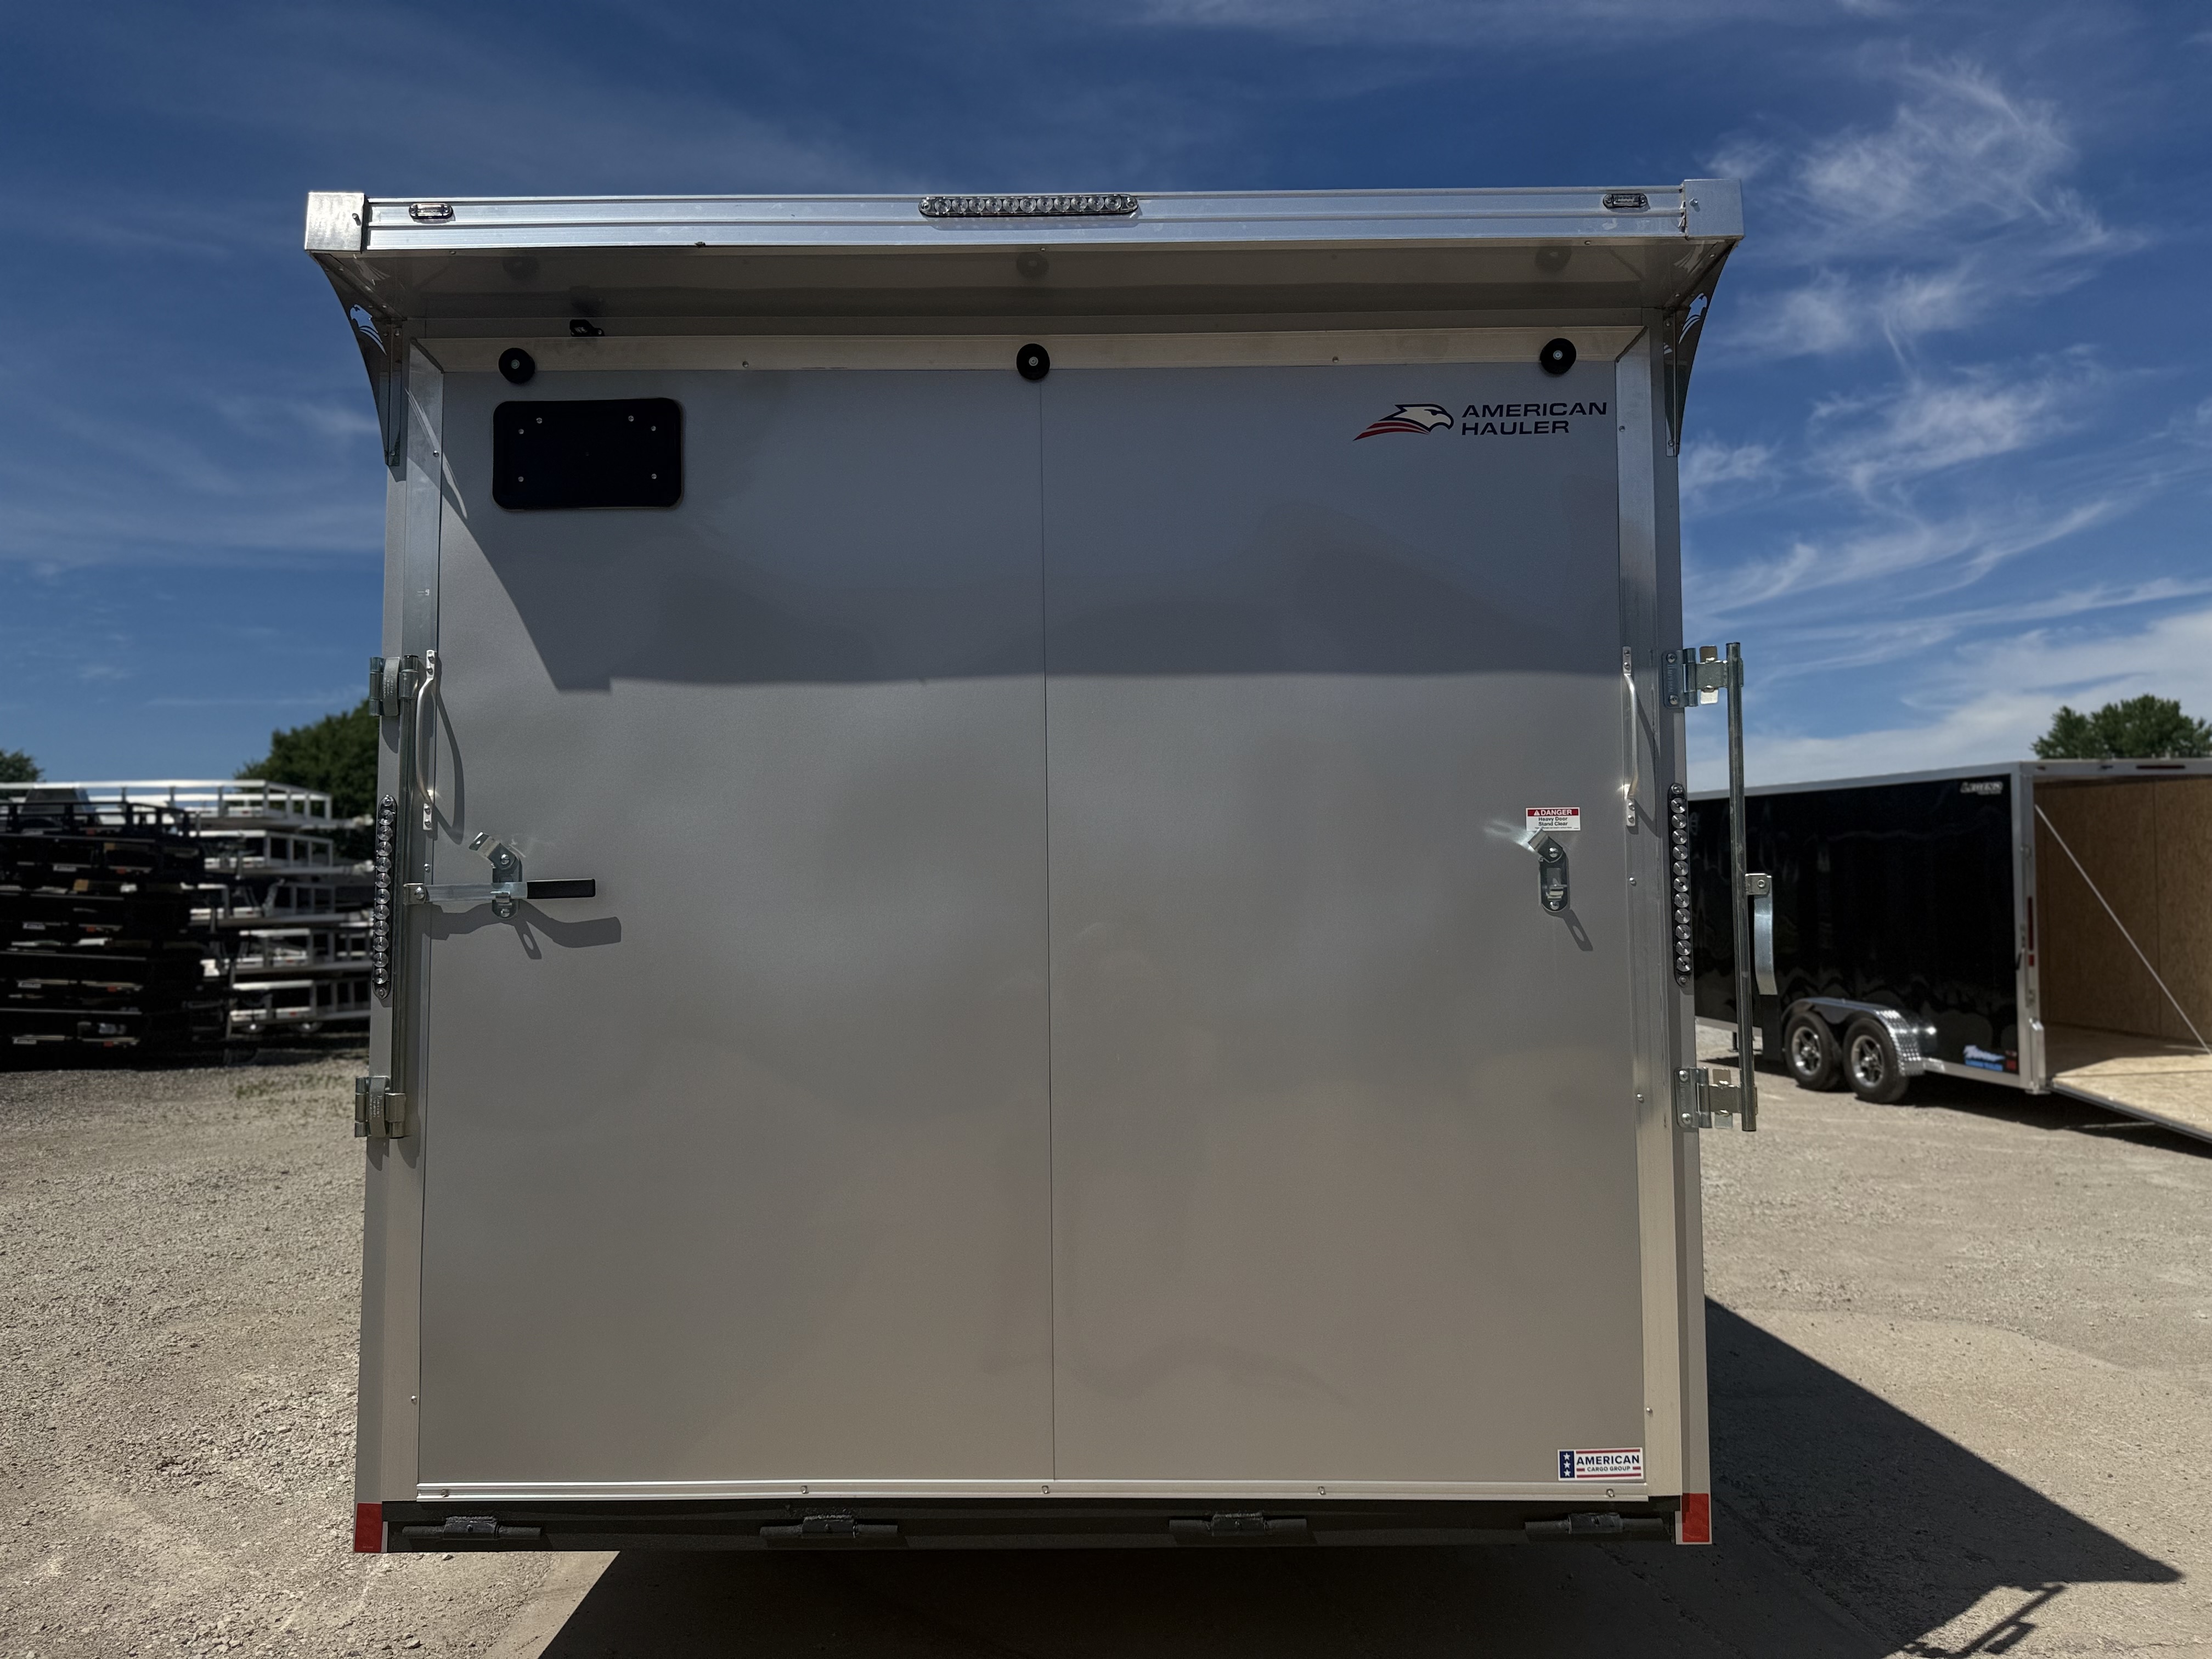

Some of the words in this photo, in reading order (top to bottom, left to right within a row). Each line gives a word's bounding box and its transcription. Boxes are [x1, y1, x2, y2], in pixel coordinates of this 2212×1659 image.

[1462, 402, 1607, 417] AMERICAN
[1462, 420, 1570, 435] HAULER
[1576, 1455, 1639, 1465] AMERICAN
